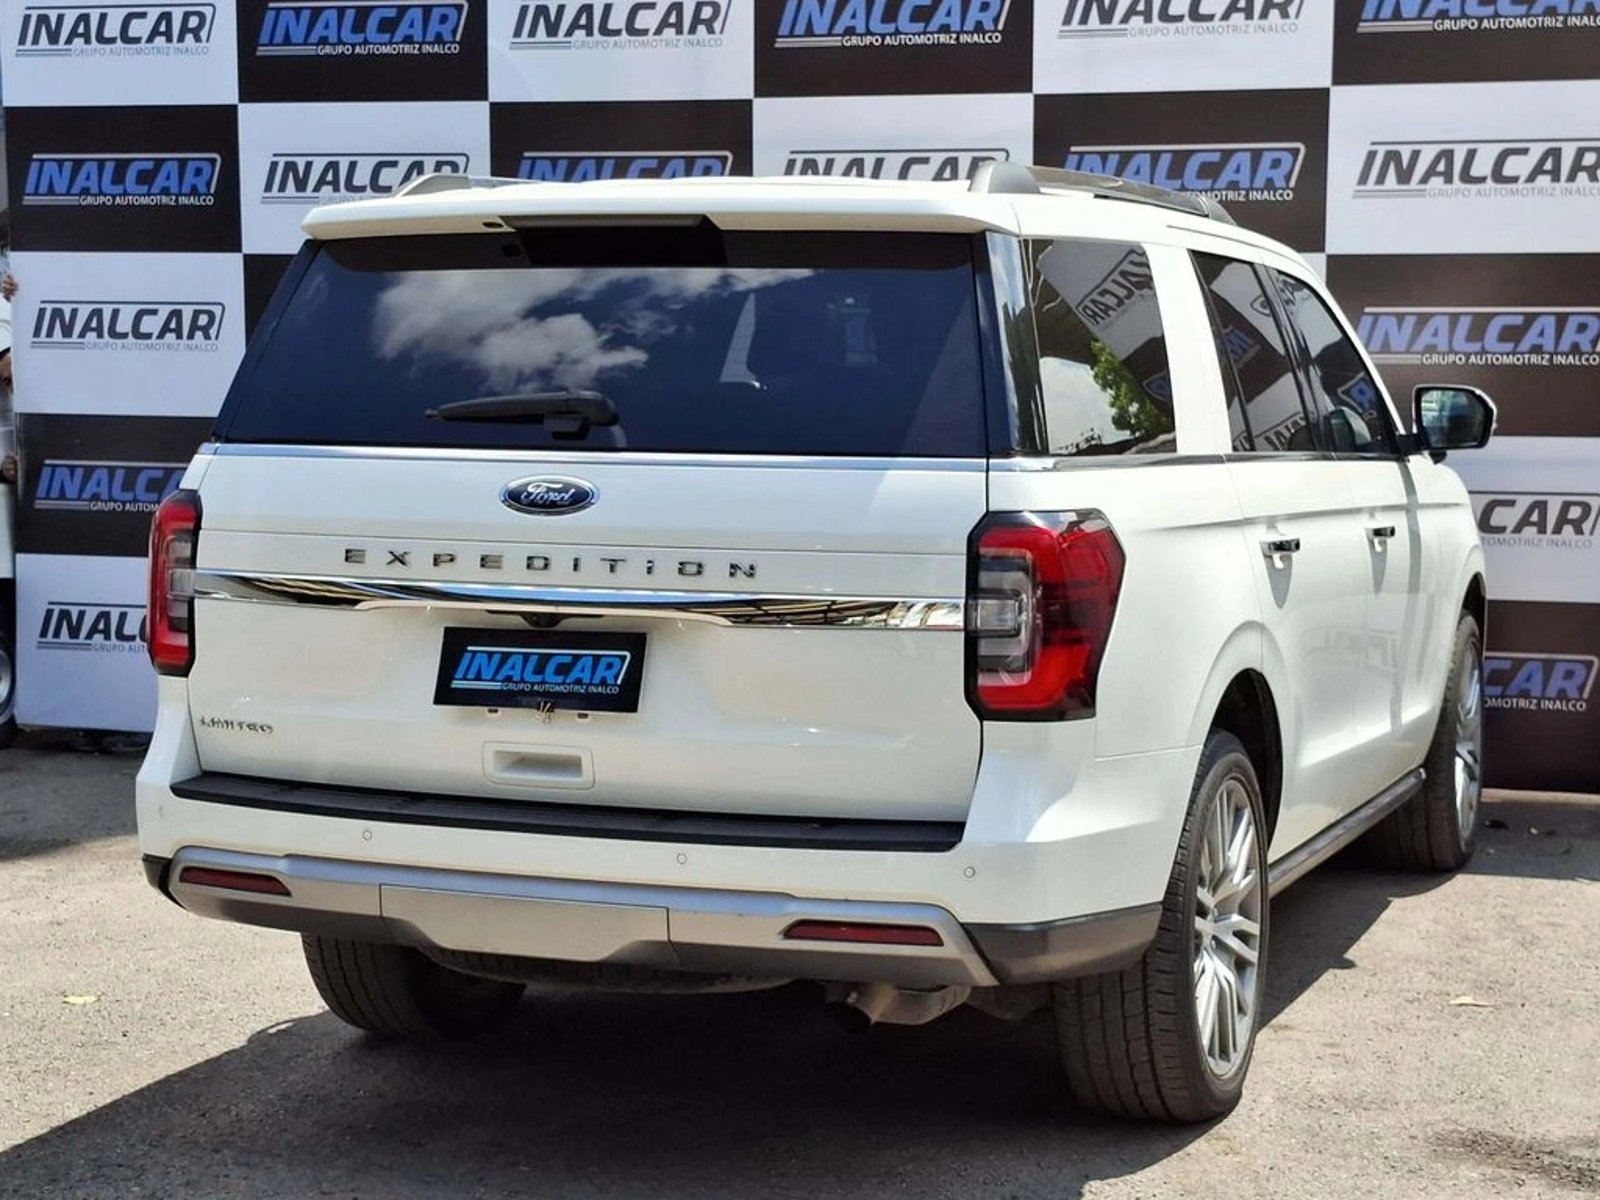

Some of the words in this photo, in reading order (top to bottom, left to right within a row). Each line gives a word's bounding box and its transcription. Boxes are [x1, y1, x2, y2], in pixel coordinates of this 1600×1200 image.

[512, 1, 722, 38] INALCAR
[778, 0, 999, 35] INALCAR
[1433, 18, 1478, 31] GRUPO
[1481, 16, 1563, 30] AUTOMOTRIZ
[18, 11, 207, 46] INALCAR
[259, 7, 459, 44] INALCAR
[1129, 26, 1169, 38] GRUPO
[1174, 24, 1250, 36] AUTOMOTRIZ
[1254, 22, 1298, 34] INALCO
[573, 39, 609, 50] GRUPO
[612, 38, 681, 49] AUTOMOTRIZ
[684, 37, 723, 48] INALCO
[842, 35, 881, 46] GRUPO
[884, 34, 957, 45] AUTOMOTRIZ
[959, 32, 1001, 44] INALCO
[73, 47, 105, 57] GRUPO
[109, 47, 170, 57] AUTOMOTRIZ
[173, 46, 209, 56] INALCO
[317, 45, 353, 55] GRUPO
[354, 44, 420, 55] AUTOMOTRIZ
[422, 43, 460, 54] INALCO
[1356, 146, 1600, 186] INALCAR
[25, 160, 213, 194] INALCAR
[1249, 188, 1294, 201] INALCO
[1427, 187, 1471, 199] GRUPO
[1474, 186, 1557, 198] AUTOMOTRIZ
[79, 195, 113, 206] GRUPO
[114, 195, 176, 206] AUTOMOTRIZ
[178, 195, 215, 206] INALCO
[32, 307, 217, 341] INALCAR
[1355, 313, 1600, 353] INALCAR
[85, 341, 118, 351] GRUPO
[121, 341, 181, 352] AUTOMOTRIZ
[183, 342, 218, 352] INALCO
[1422, 353, 1465, 365] GRUPO
[1468, 353, 1549, 365] AUTOMOTRIZ
[1553, 353, 1600, 366] INALCO
[521, 482, 576, 504] Ford
[90, 501, 123, 511] GRUPO
[344, 548, 757, 578] EXPEDITION
[454, 652, 623, 684] INALCAR
[502, 682, 532, 692] GRUPO
[533, 684, 586, 693] AUTOMOTRIZ
[587, 685, 620, 695] INALCO
[1540, 699, 1587, 712] INALCO
